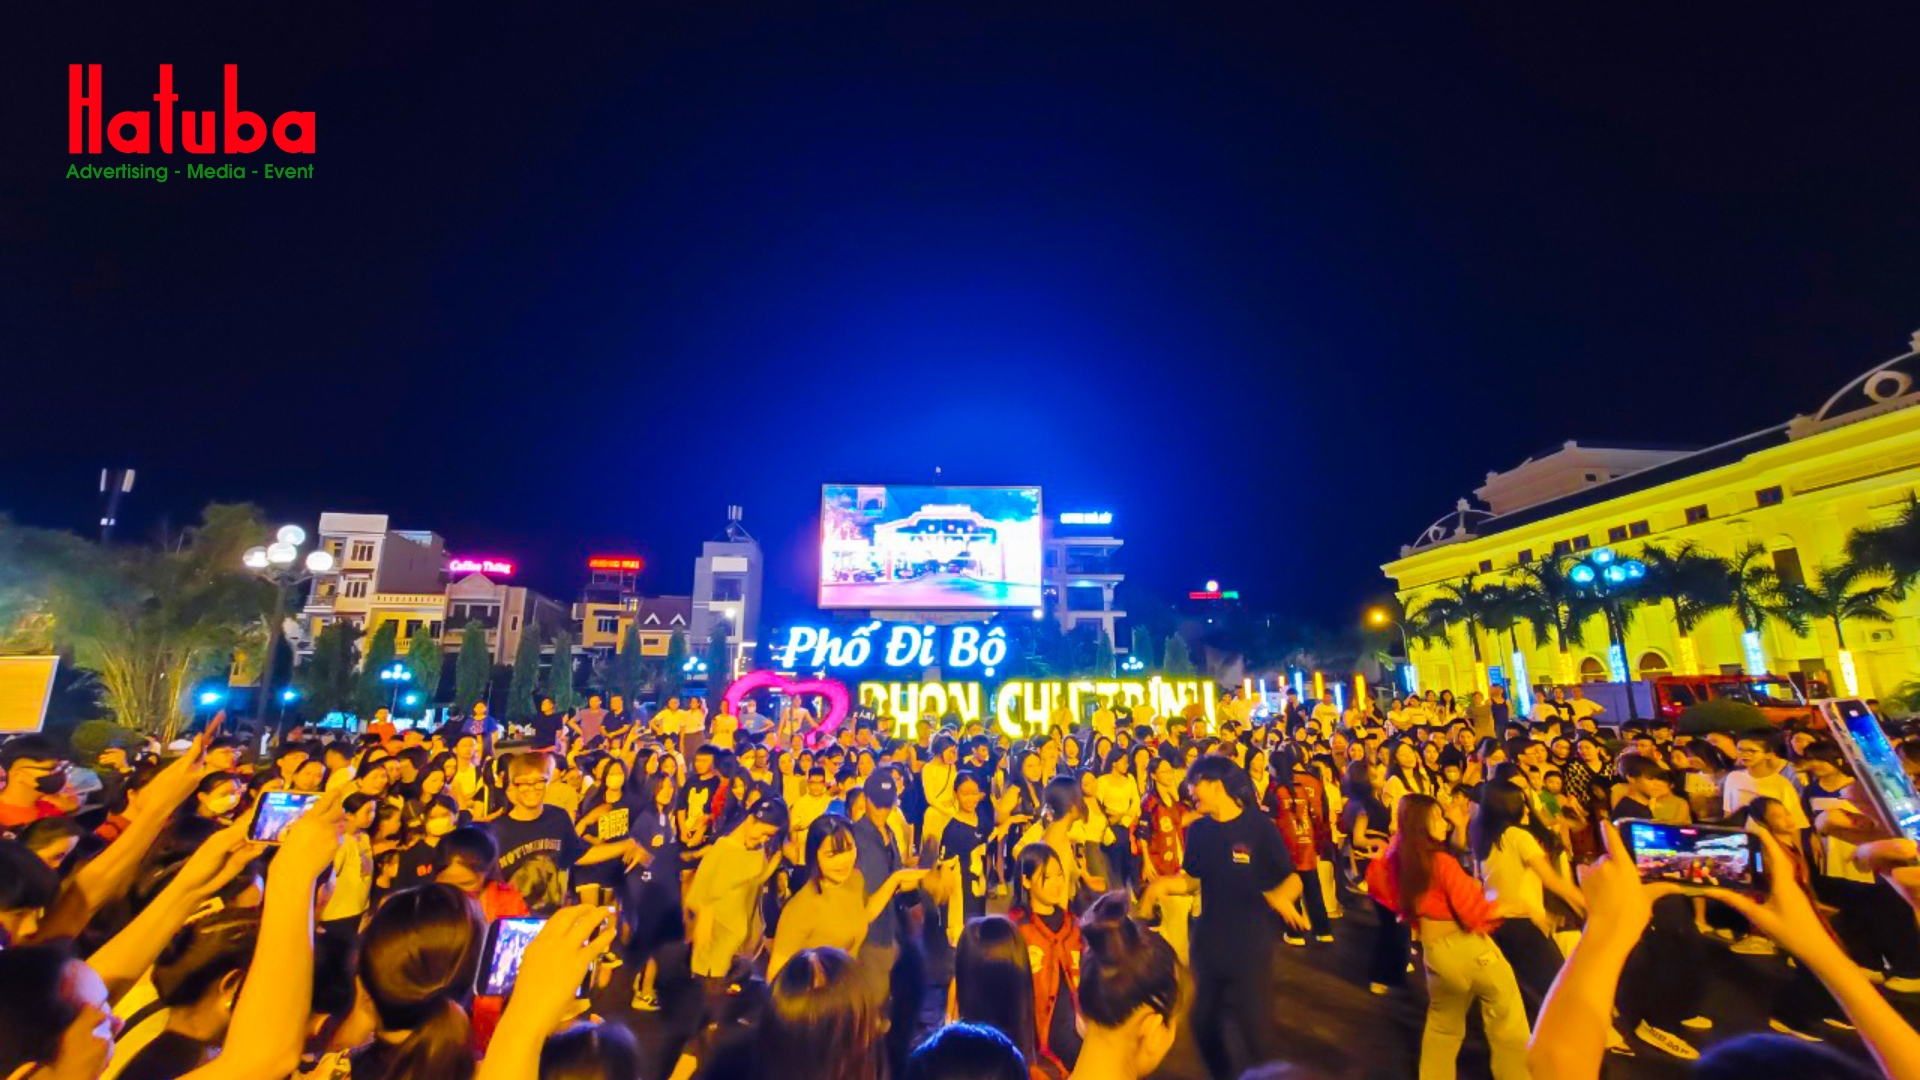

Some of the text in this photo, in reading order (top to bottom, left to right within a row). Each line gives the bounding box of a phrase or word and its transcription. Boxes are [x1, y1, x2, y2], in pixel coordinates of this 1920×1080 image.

[782, 620, 1007, 677] Phố Đi Bộ
